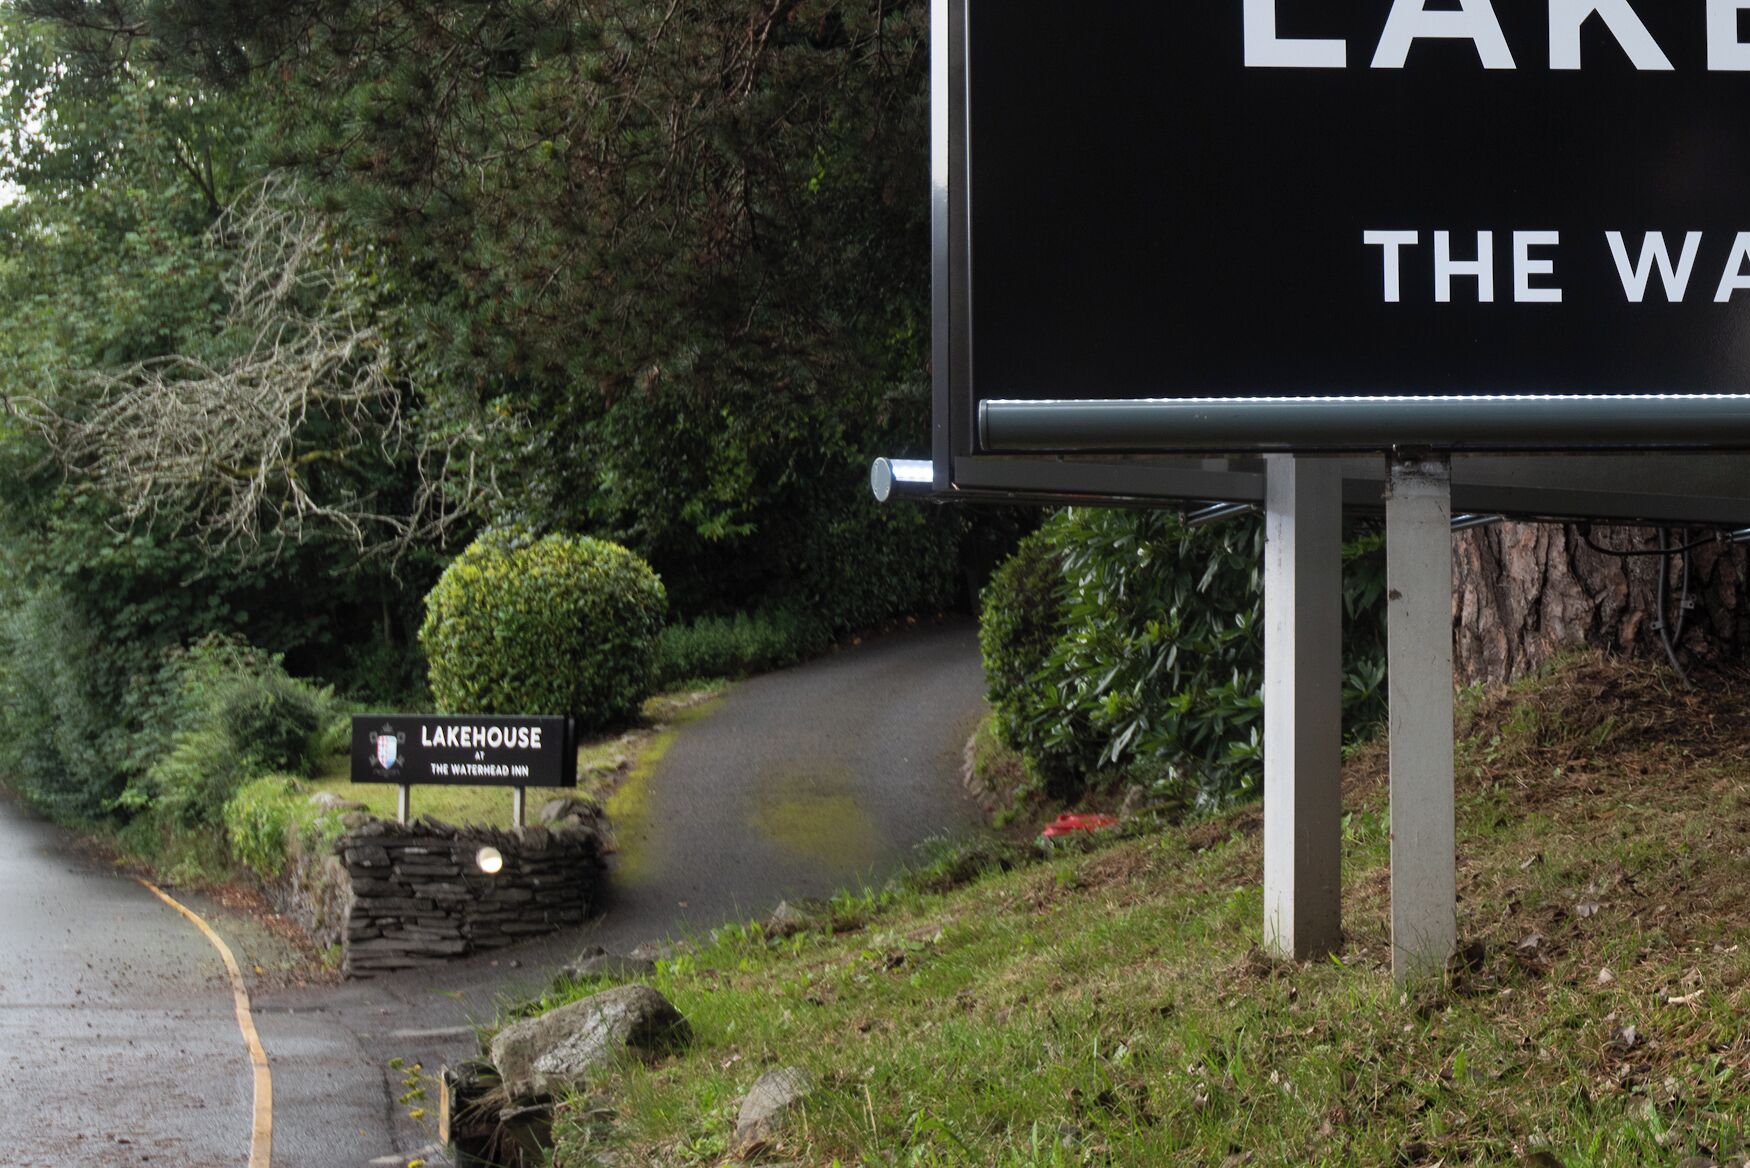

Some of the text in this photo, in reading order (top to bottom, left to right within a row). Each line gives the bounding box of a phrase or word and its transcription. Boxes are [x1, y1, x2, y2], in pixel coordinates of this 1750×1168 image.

[1363, 230, 1563, 304] THE
[421, 725, 542, 749] LAKEHOUSE
[474, 750, 485, 761] AT
[430, 762, 529, 777] THE WATERHEAD INN
